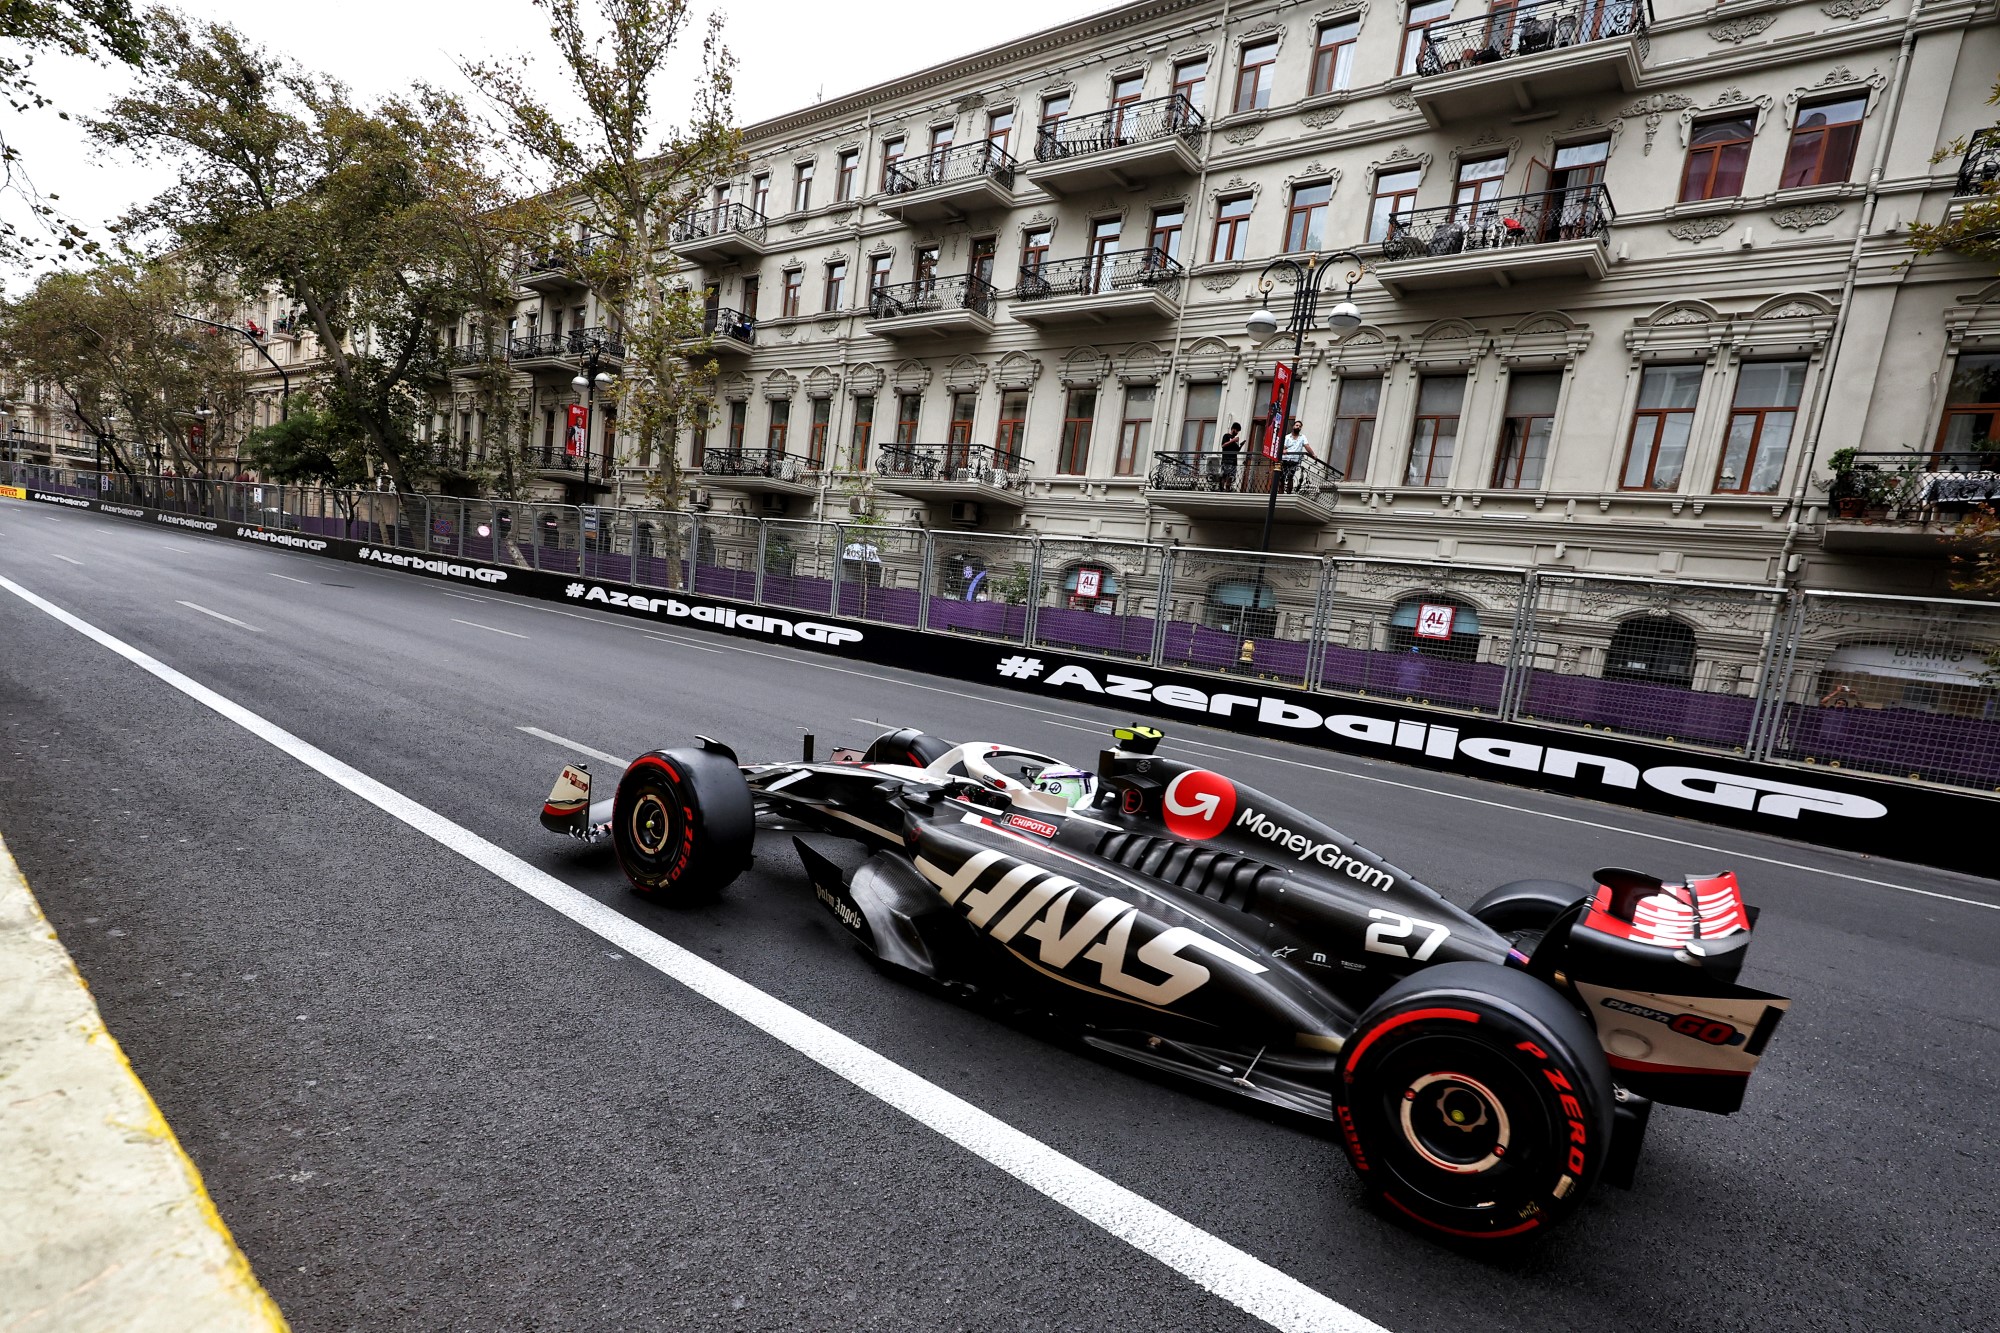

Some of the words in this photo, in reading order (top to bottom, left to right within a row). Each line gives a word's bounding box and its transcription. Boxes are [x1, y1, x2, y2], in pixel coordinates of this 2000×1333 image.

[34, 493, 90, 508] #AzerbaijanGP
[100, 504, 144, 518] #AzerbaijanGP
[157, 513, 218, 531] #AzerbaijanGP
[237, 527, 328, 551] #AzerbaijanGP
[358, 547, 508, 584] #AzerbaijanGP
[1082, 576, 1095, 587] AL
[565, 582, 864, 646] #AzerbaijanGP
[1425, 612, 1444, 625] AL
[996, 655, 1888, 820] #AzerbaijanGP
[1012, 817, 1055, 836] CHIPOTLE
[1236, 807, 1395, 892] MoneyGram
[834, 896, 861, 929] Angels
[914, 849, 1270, 1006] HAAS
[1365, 908, 1451, 962] 27
[1607, 1000, 1671, 1023] PLAY'n
[1671, 1014, 1735, 1044] GO
[1542, 1067, 1587, 1176] ZERO
